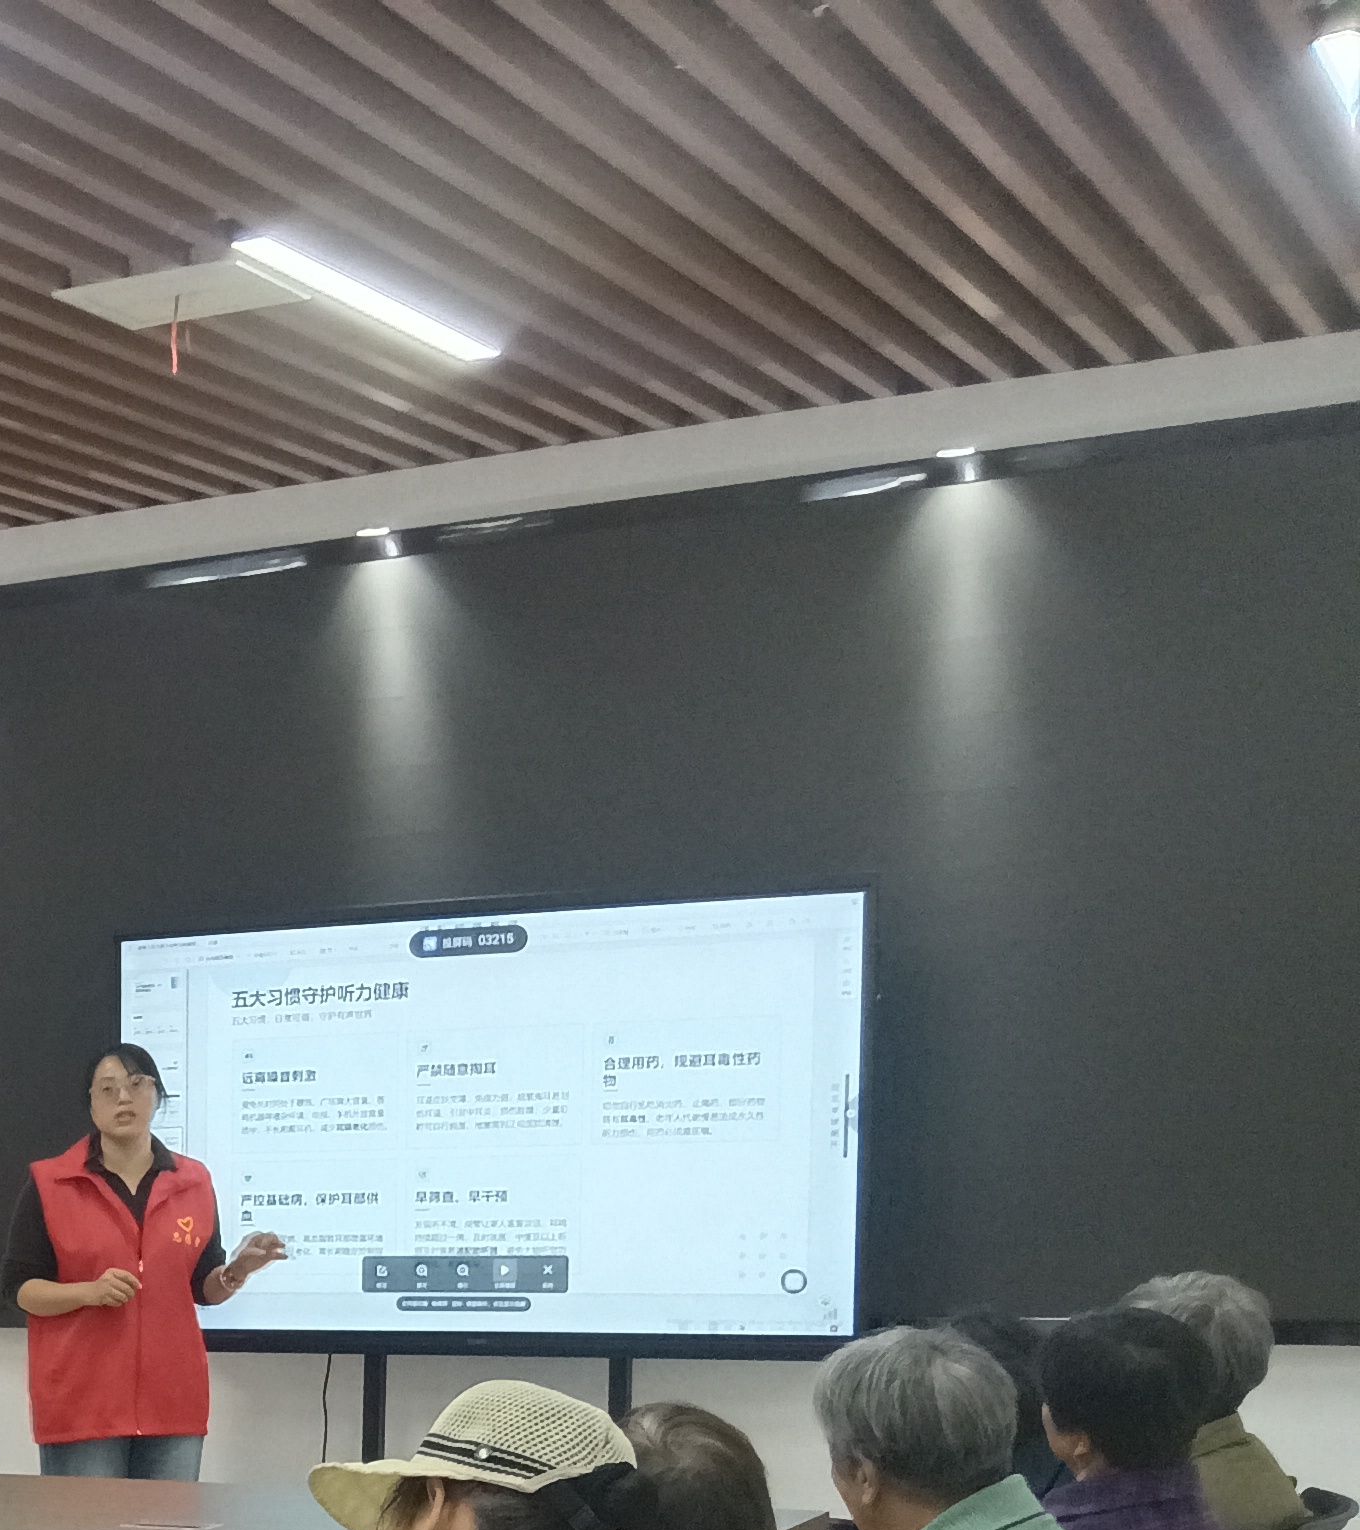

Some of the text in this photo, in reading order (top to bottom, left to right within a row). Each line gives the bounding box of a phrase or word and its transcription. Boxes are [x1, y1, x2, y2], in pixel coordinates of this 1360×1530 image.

[231, 982, 409, 1008] 五大习惯守护听力健康
